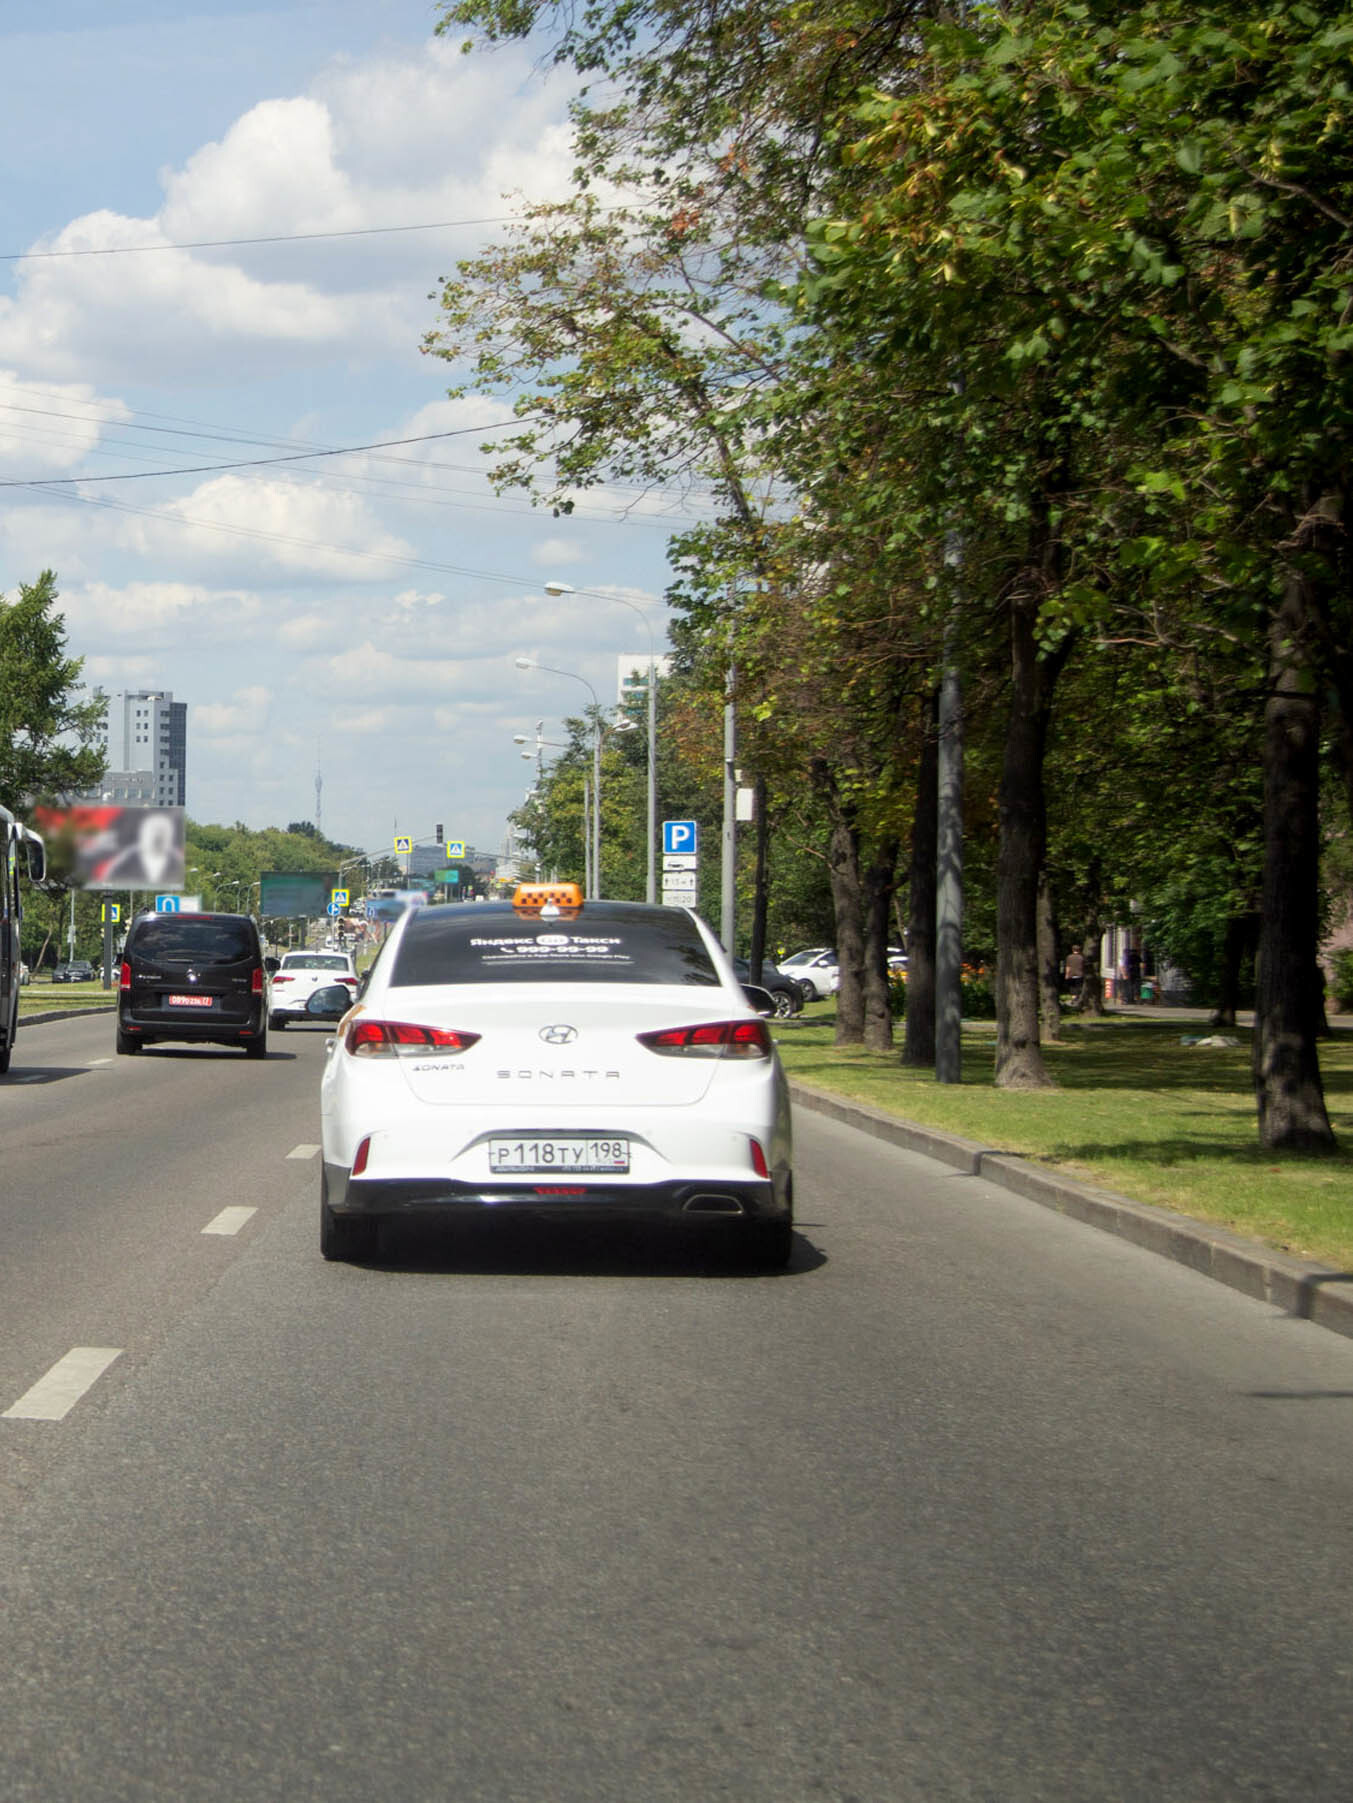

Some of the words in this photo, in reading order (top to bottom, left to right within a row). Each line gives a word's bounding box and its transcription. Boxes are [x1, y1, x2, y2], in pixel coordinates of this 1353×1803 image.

[671, 825, 690, 850] P
[470, 937, 535, 946] Яндекс
[570, 936, 622, 945] Такси
[497, 1070, 621, 1080] SONATA
